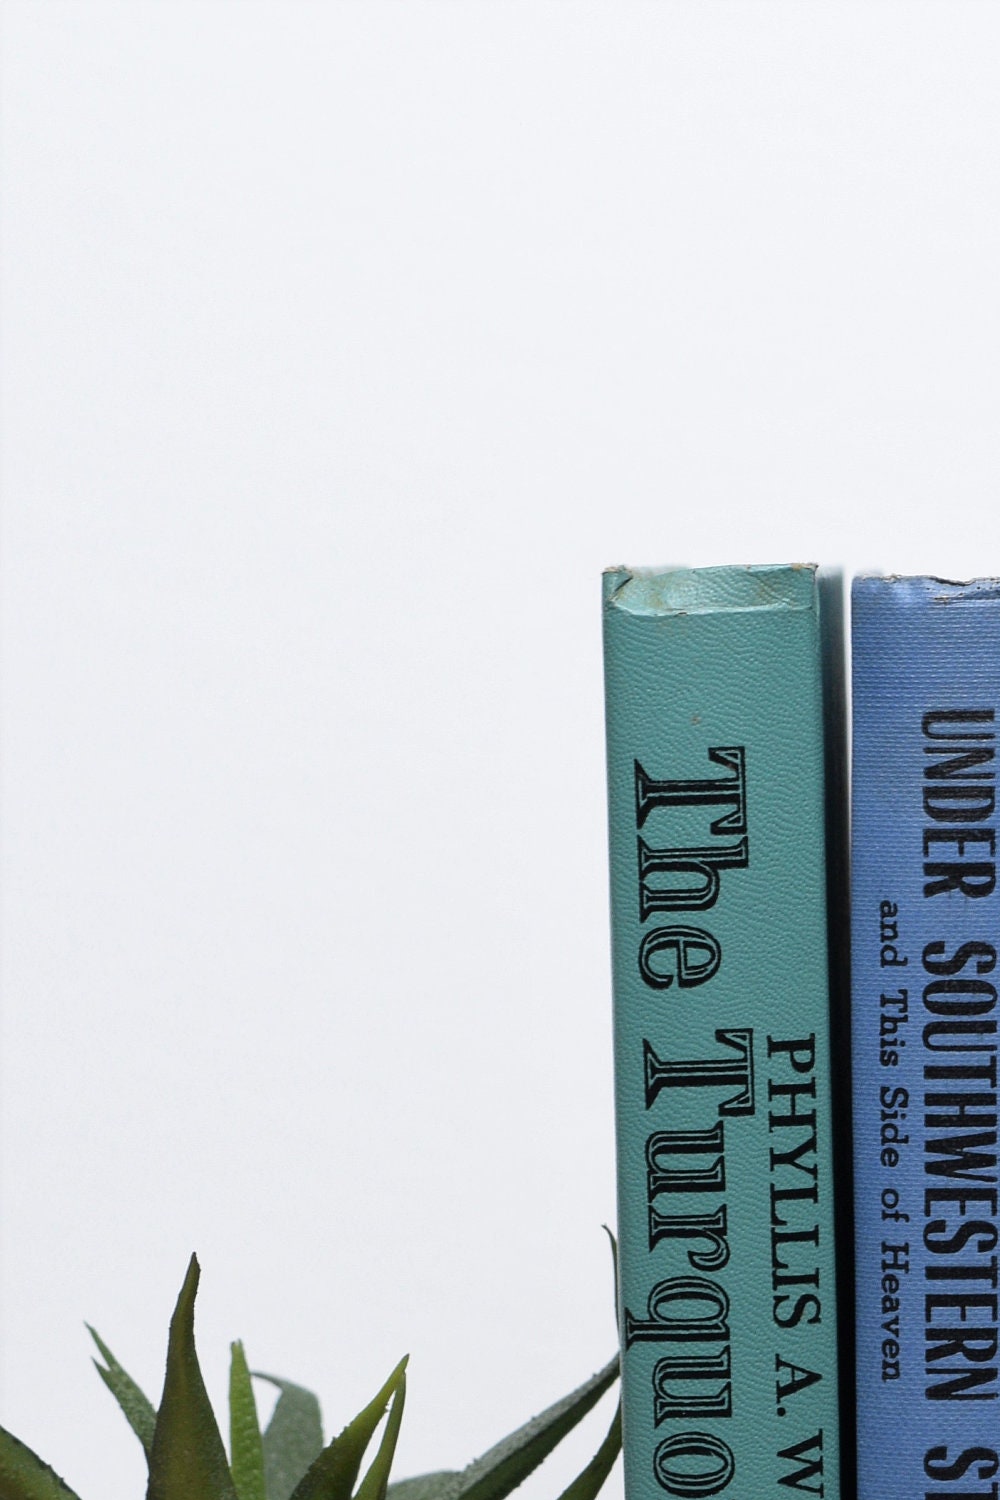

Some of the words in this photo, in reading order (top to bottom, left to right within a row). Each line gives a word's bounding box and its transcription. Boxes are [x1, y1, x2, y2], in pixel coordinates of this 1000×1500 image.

[922, 710, 996, 898] UNDER
[634, 746, 749, 990] The
[880, 901, 908, 967] and
[880, 989, 908, 1066] This
[767, 1033, 821, 1328] PHYLLIS
[880, 1086, 909, 1167] Side
[922, 941, 998, 1400] SOUTHWESTERN
[882, 1189, 909, 1222] of
[881, 1242, 909, 1381] Heaven
[776, 1354, 822, 1416] A.
